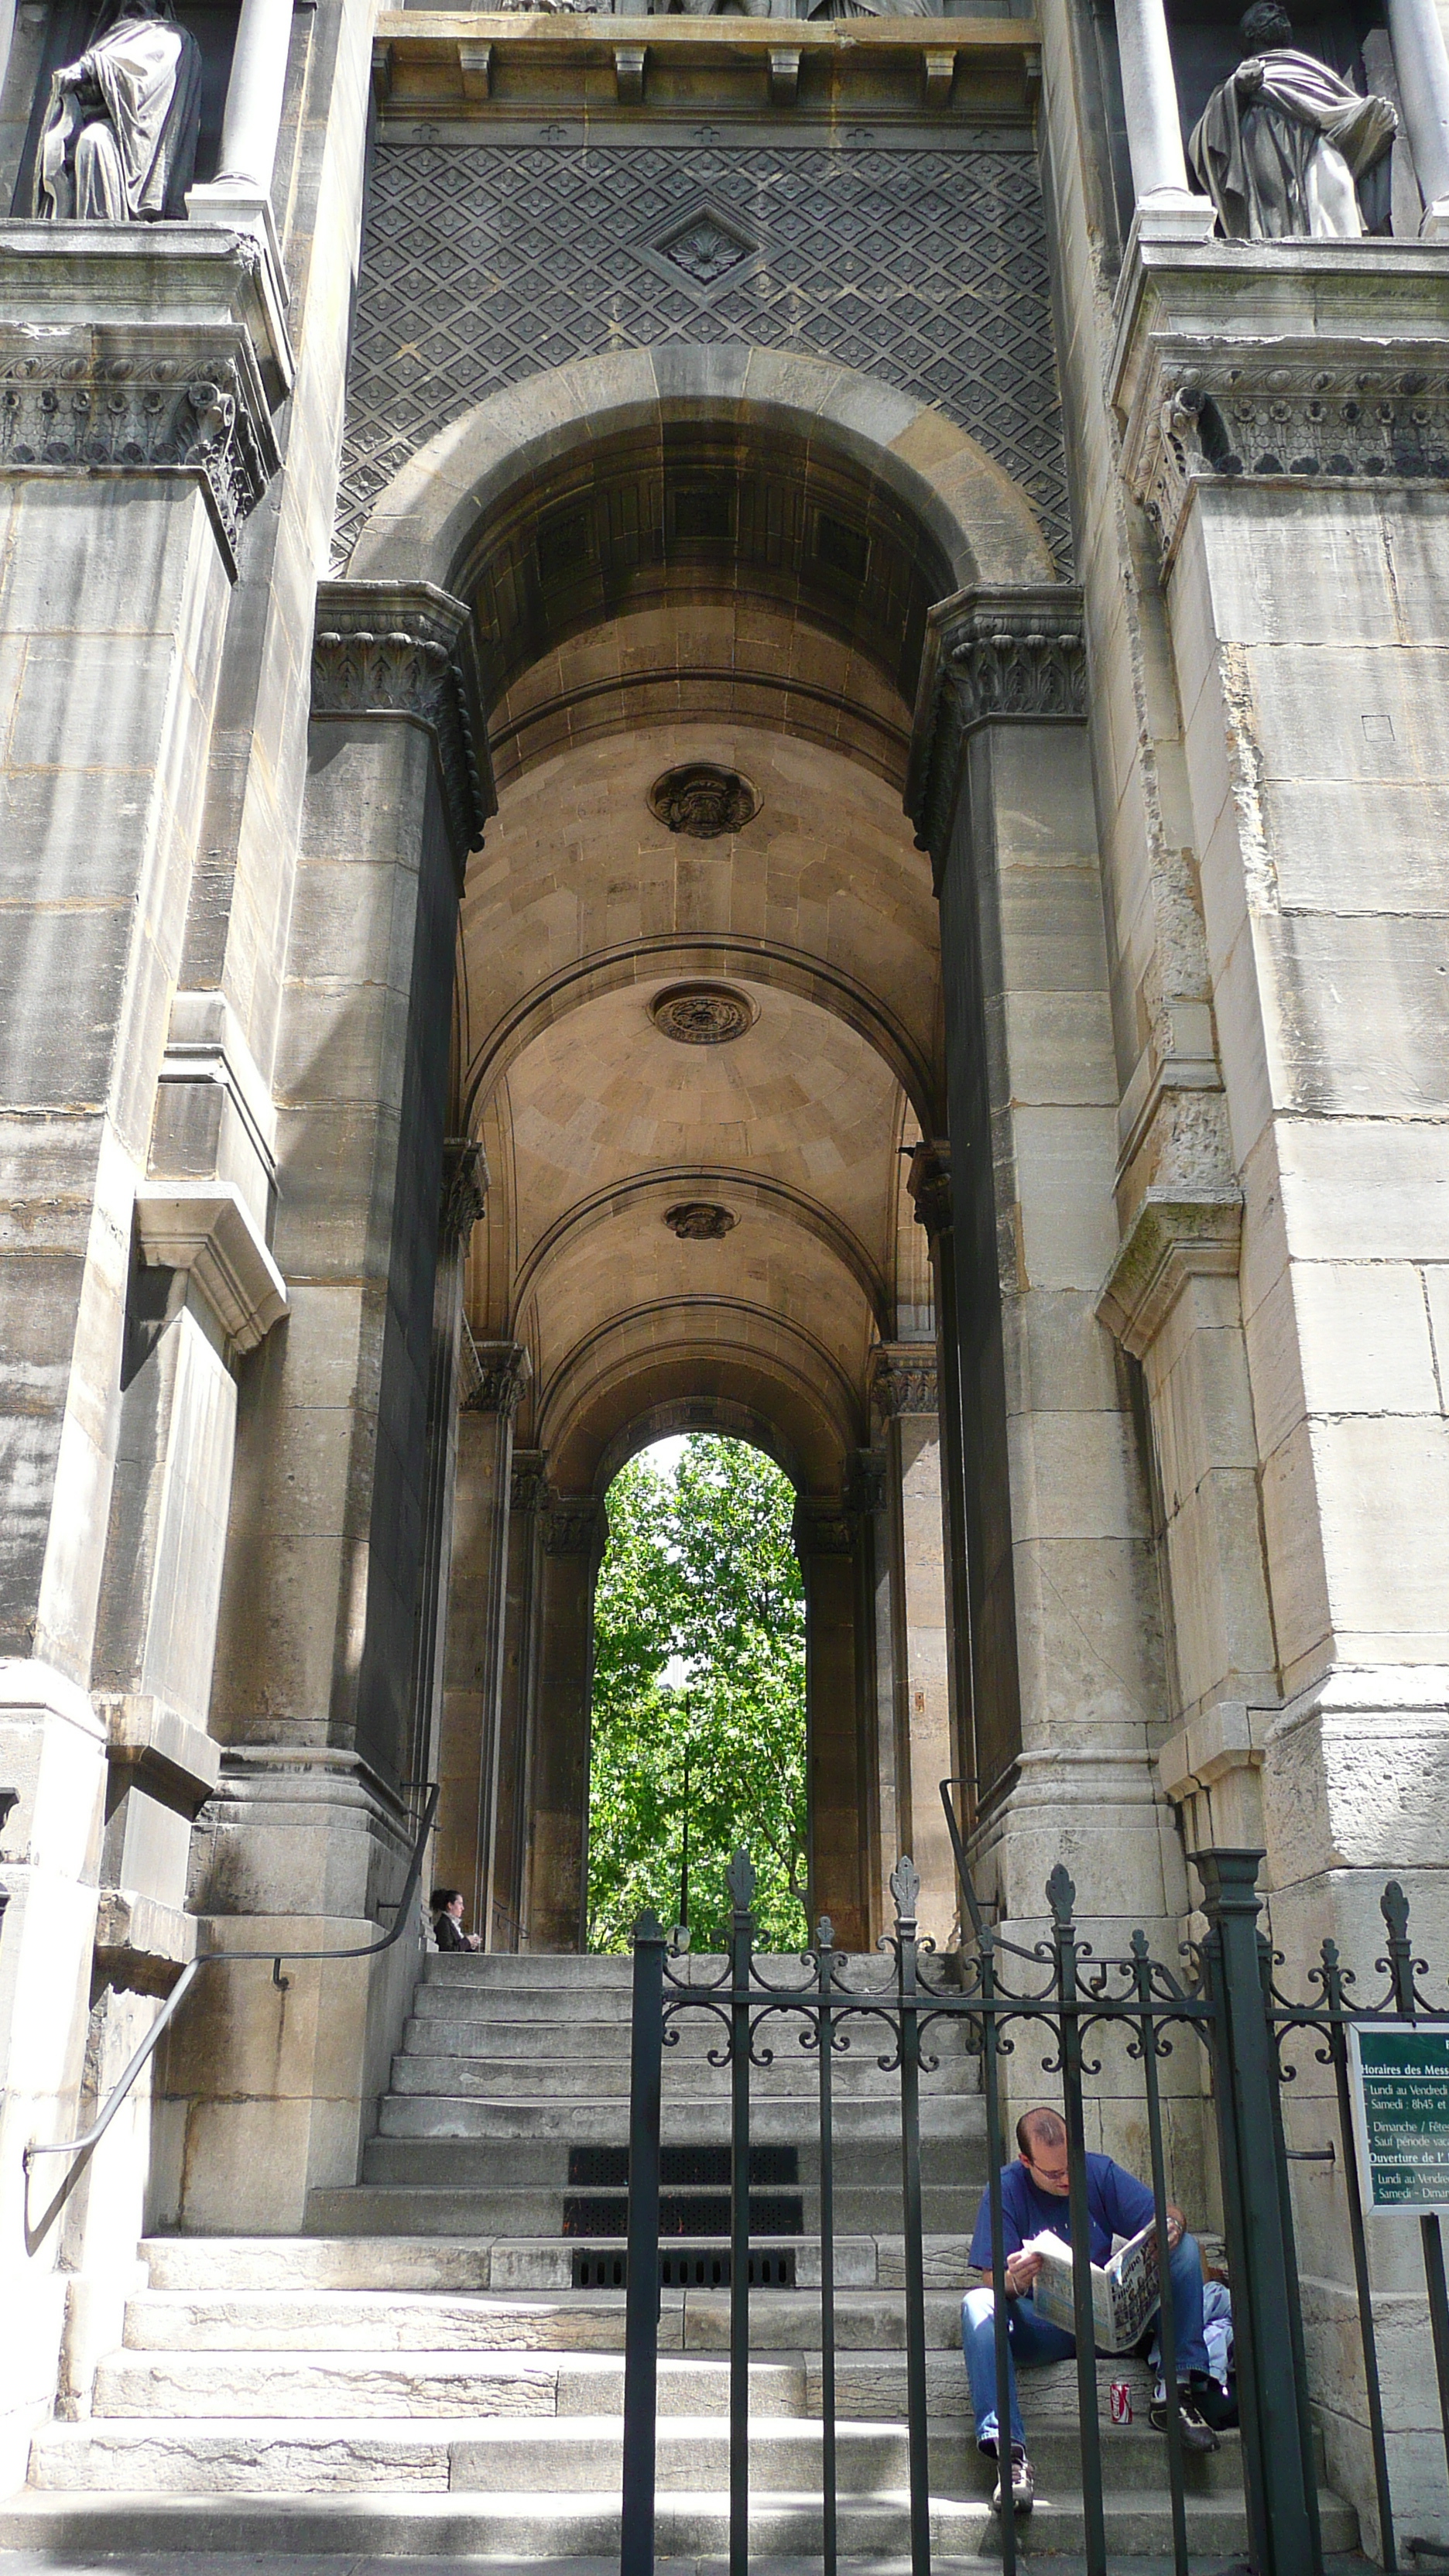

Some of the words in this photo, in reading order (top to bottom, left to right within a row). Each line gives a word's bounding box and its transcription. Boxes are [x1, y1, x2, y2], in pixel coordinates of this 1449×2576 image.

[1361, 2064, 1401, 2074] Horaires
[1404, 2064, 1421, 2075] des
[1370, 2084, 1393, 2095] Lundi
[1396, 2087, 1407, 2095] au
[1410, 2084, 1447, 2095] Vendredi
[1371, 2098, 1403, 2109] Samedi
[1412, 2098, 1434, 2110] 8h45
[1437, 2100, 1447, 2109] et
[1373, 2121, 1417, 2132] Dimanche
[1374, 2135, 1393, 2146] Sauf
[1396, 2135, 1430, 2150] période
[1369, 2153, 1418, 2163] Ouverture
[1422, 2152, 1434, 2163] de
[1378, 2173, 1401, 2184] Lundi
[1404, 2175, 1416, 2184] au
[1379, 2187, 1411, 2198] Samedi
